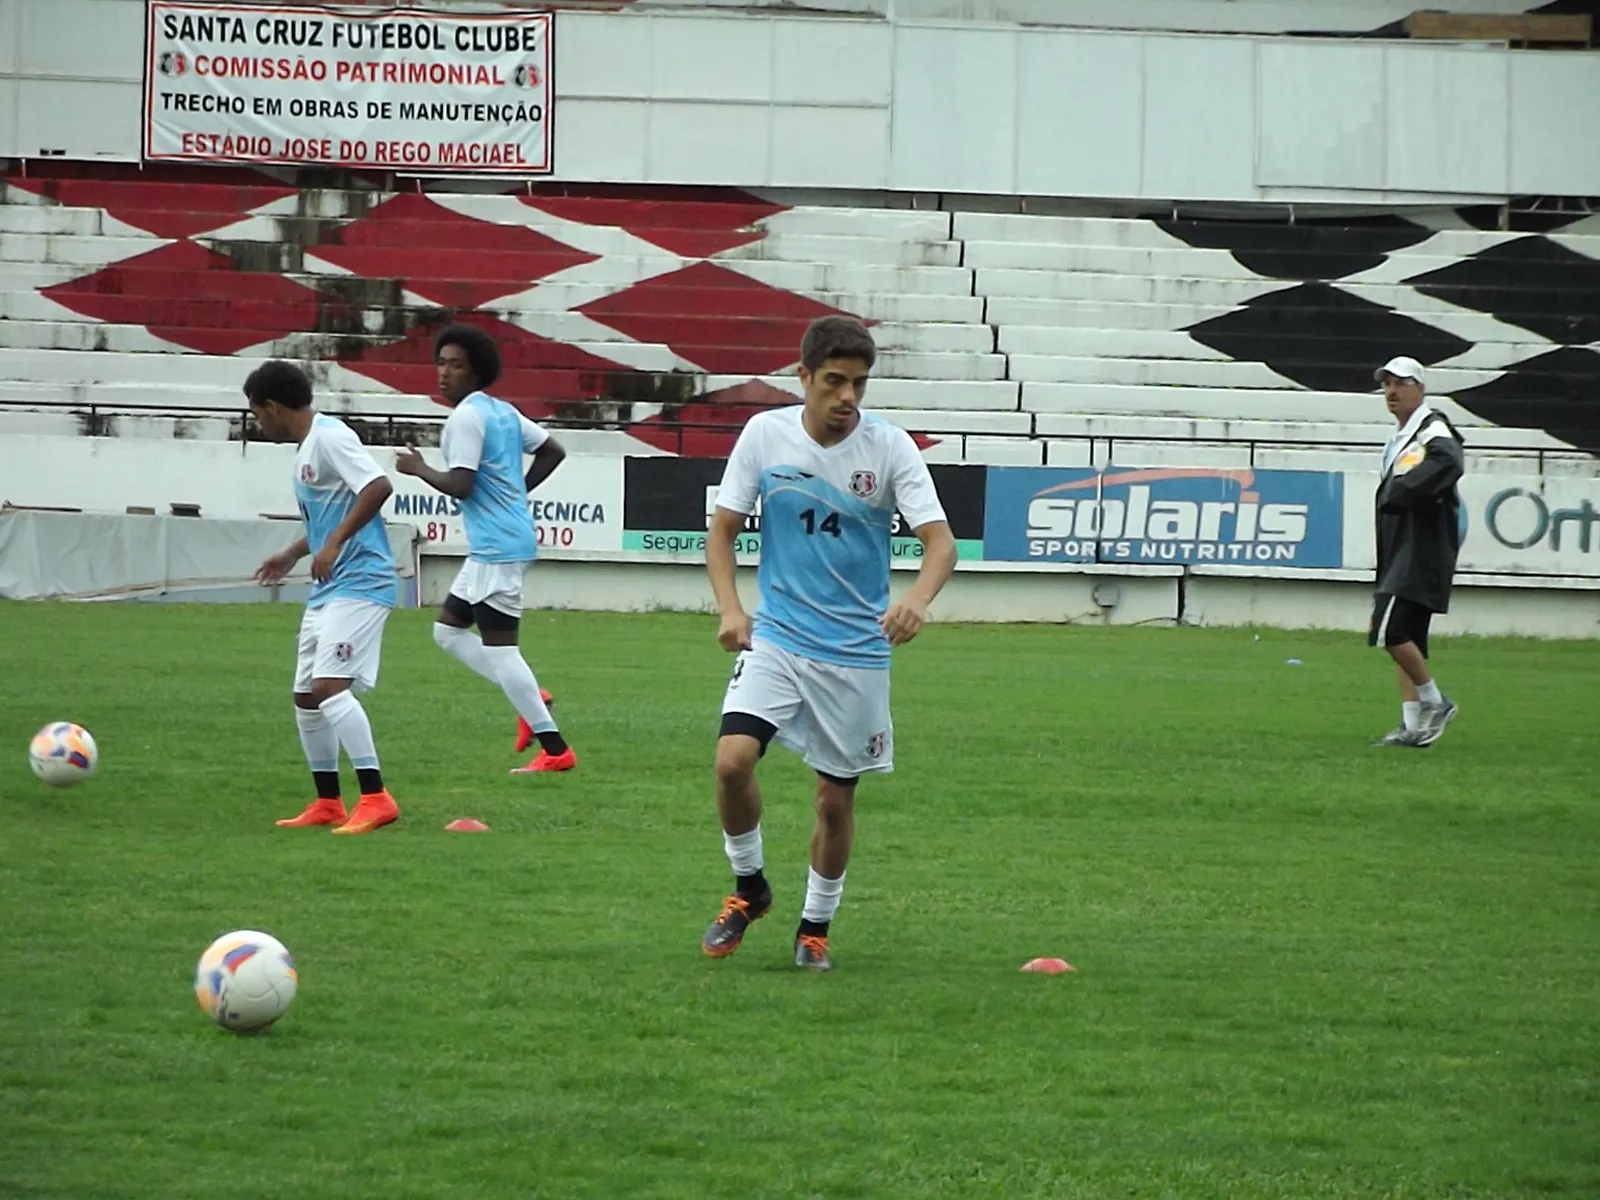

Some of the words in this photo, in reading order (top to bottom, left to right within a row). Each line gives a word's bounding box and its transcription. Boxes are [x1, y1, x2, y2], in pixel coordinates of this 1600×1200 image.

[163, 14, 246, 44] SANTA
[255, 18, 323, 47] CRUZ
[332, 23, 446, 51] FUTEBOL
[454, 26, 536, 52] CLUBE
[194, 54, 327, 81] COMISSÃO
[160, 92, 246, 114] TRECHO
[253, 98, 282, 116] EM
[289, 99, 359, 118] OBRAS
[367, 102, 392, 120] DE
[399, 100, 542, 127] MANUTENÇÃO
[182, 129, 272, 156] ESTÁDIO
[340, 140, 368, 161] DO
[375, 141, 431, 163] REGO
[438, 143, 527, 164] MACIAEL
[394, 494, 462, 516] MINAS
[528, 500, 605, 524] ECNICA
[799, 508, 842, 538] 14
[1026, 484, 1309, 543] solaris
[1485, 487, 1600, 554] Ort
[427, 521, 447, 542] 81
[1029, 540, 1131, 557] SPORTS
[1140, 542, 1297, 561] NUTRITION
